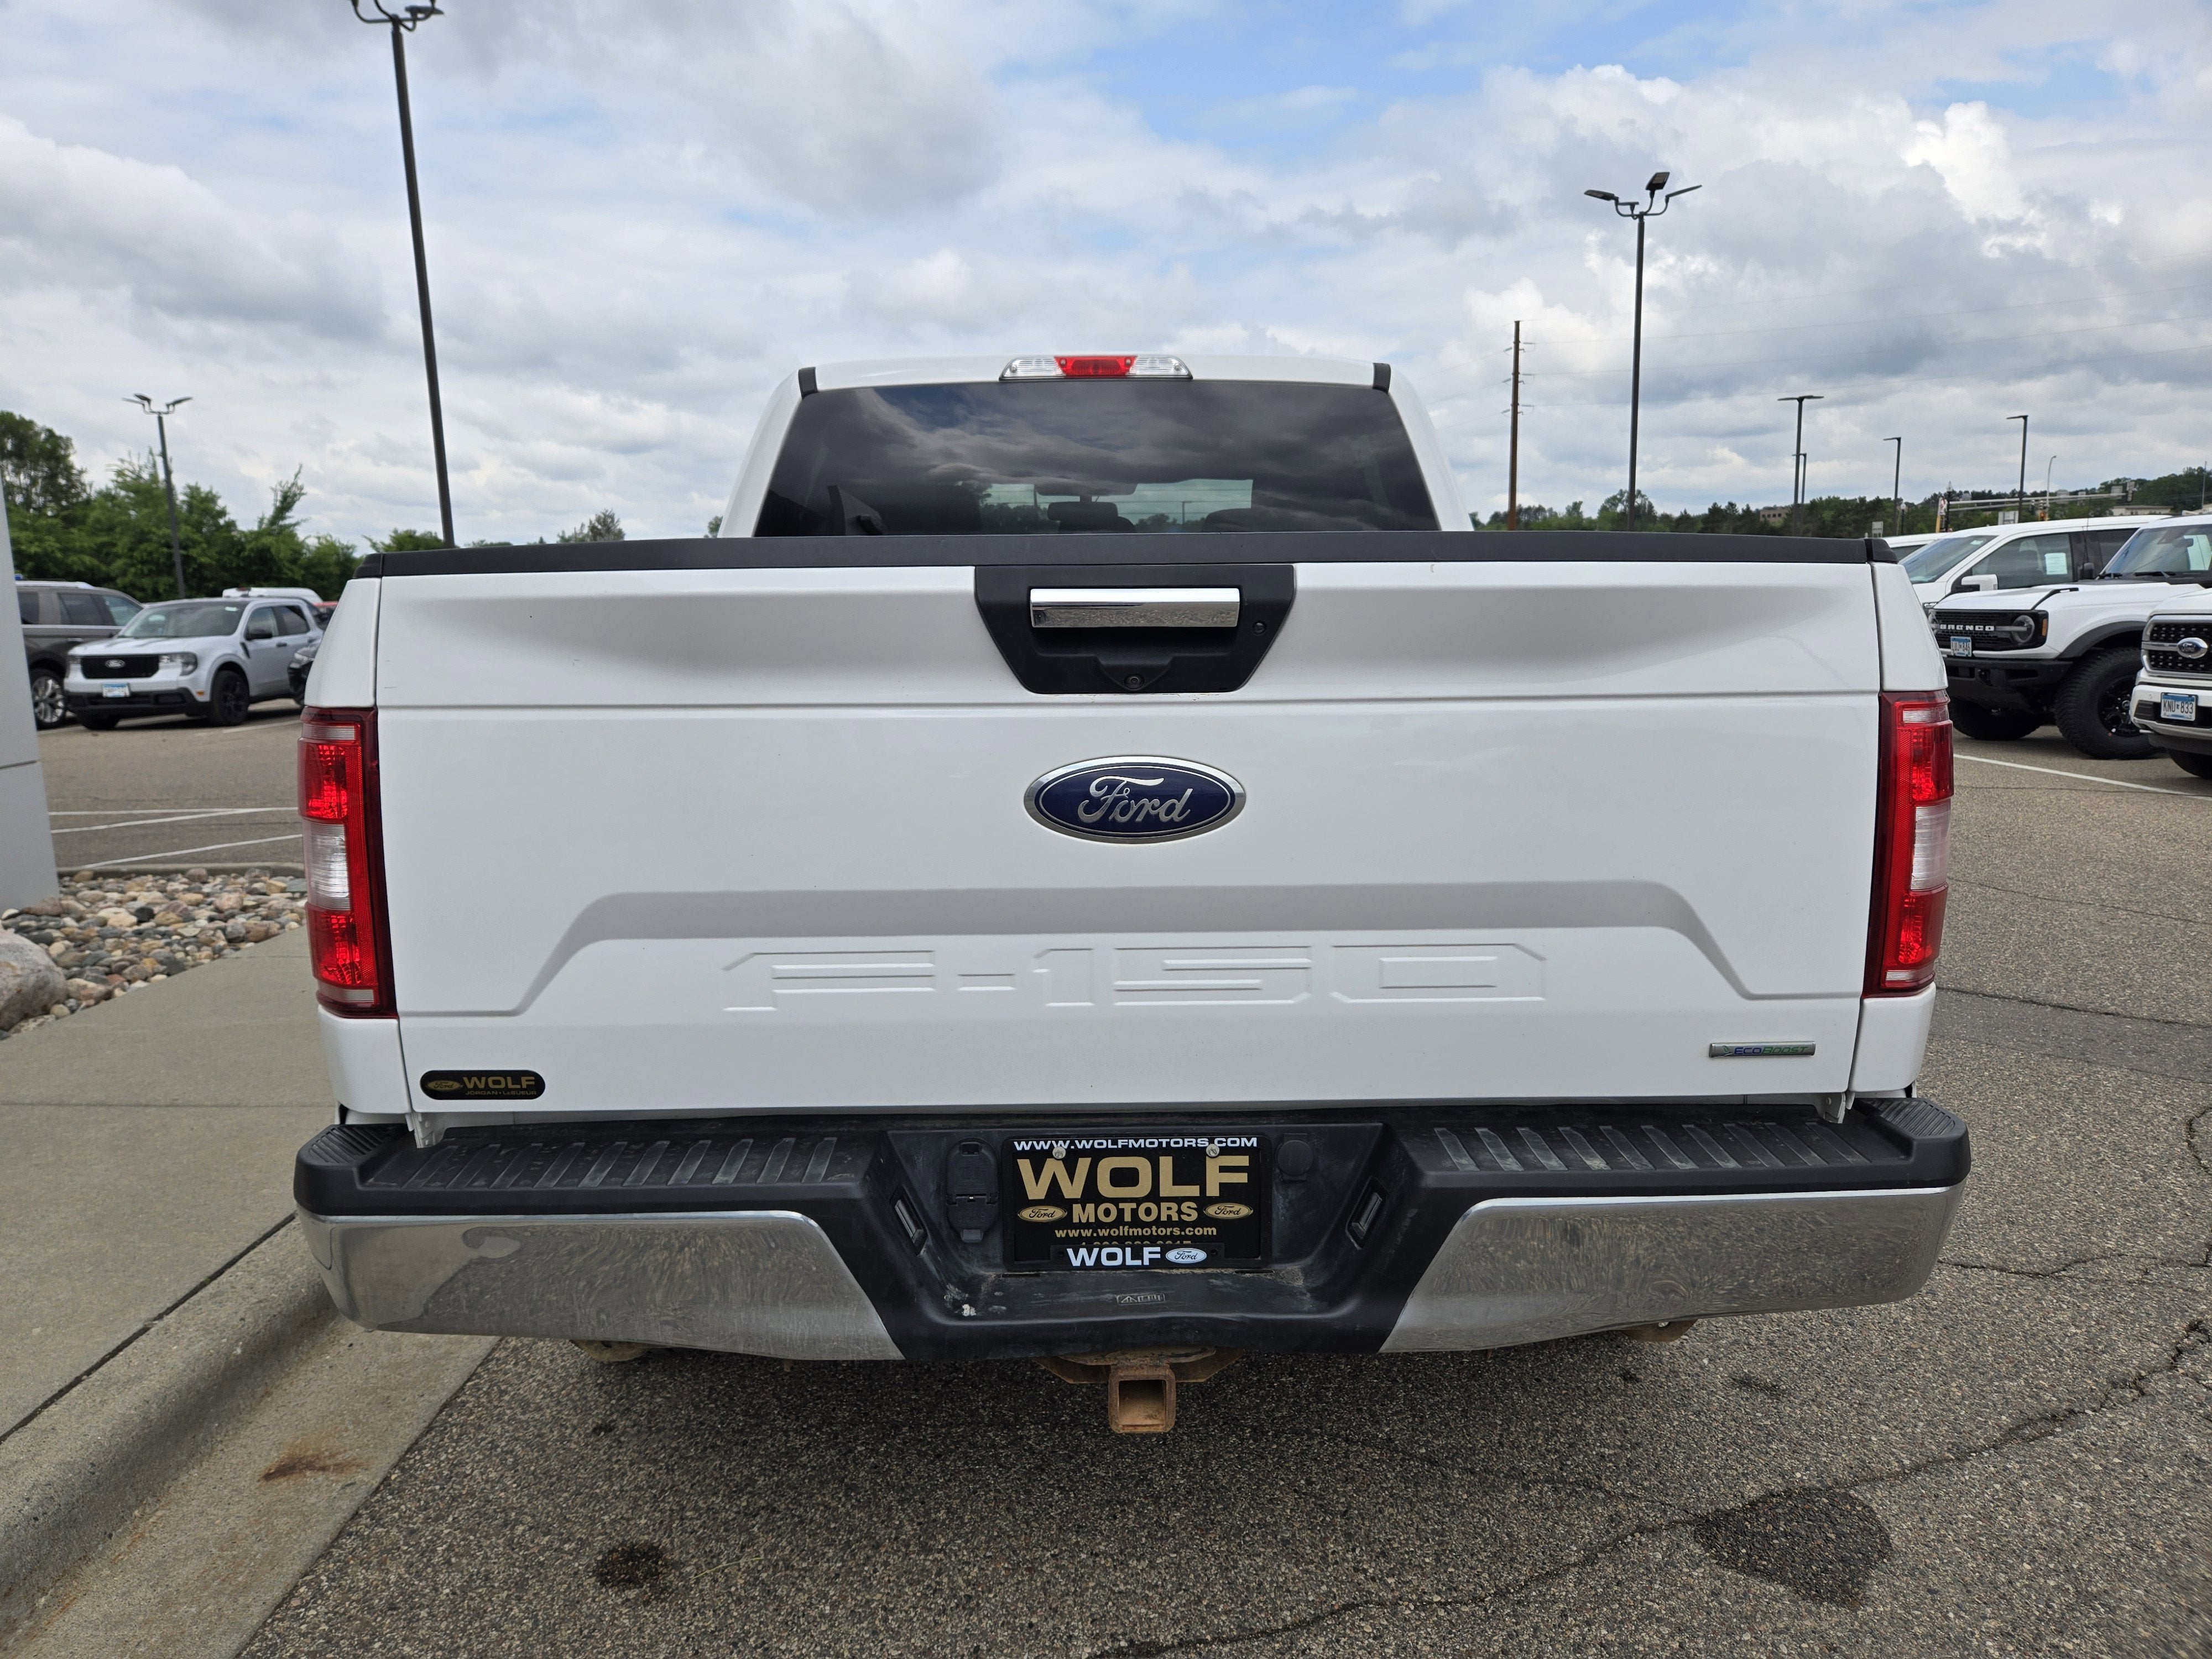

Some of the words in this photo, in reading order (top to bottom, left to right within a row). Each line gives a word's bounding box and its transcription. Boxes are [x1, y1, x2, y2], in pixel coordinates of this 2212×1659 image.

[2163, 700, 2176, 712] KNU
[2180, 701, 2194, 714] 833
[1077, 775, 1194, 823] Ford
[722, 943, 1547, 1011] F-150
[462, 1076, 535, 1089] WOLF
[1014, 1137, 1258, 1151] WWW.WOLFMOTORSCOM
[1016, 1155, 1250, 1200] WOLF
[1029, 1208, 1056, 1219] Ford
[1072, 1201, 1198, 1223] MOTORS
[1214, 1206, 1241, 1216] Ford
[1055, 1225, 1217, 1238] www.wolfmotors.com
[1066, 1246, 1161, 1267] WOLF
[1174, 1250, 1199, 1260] Ford
